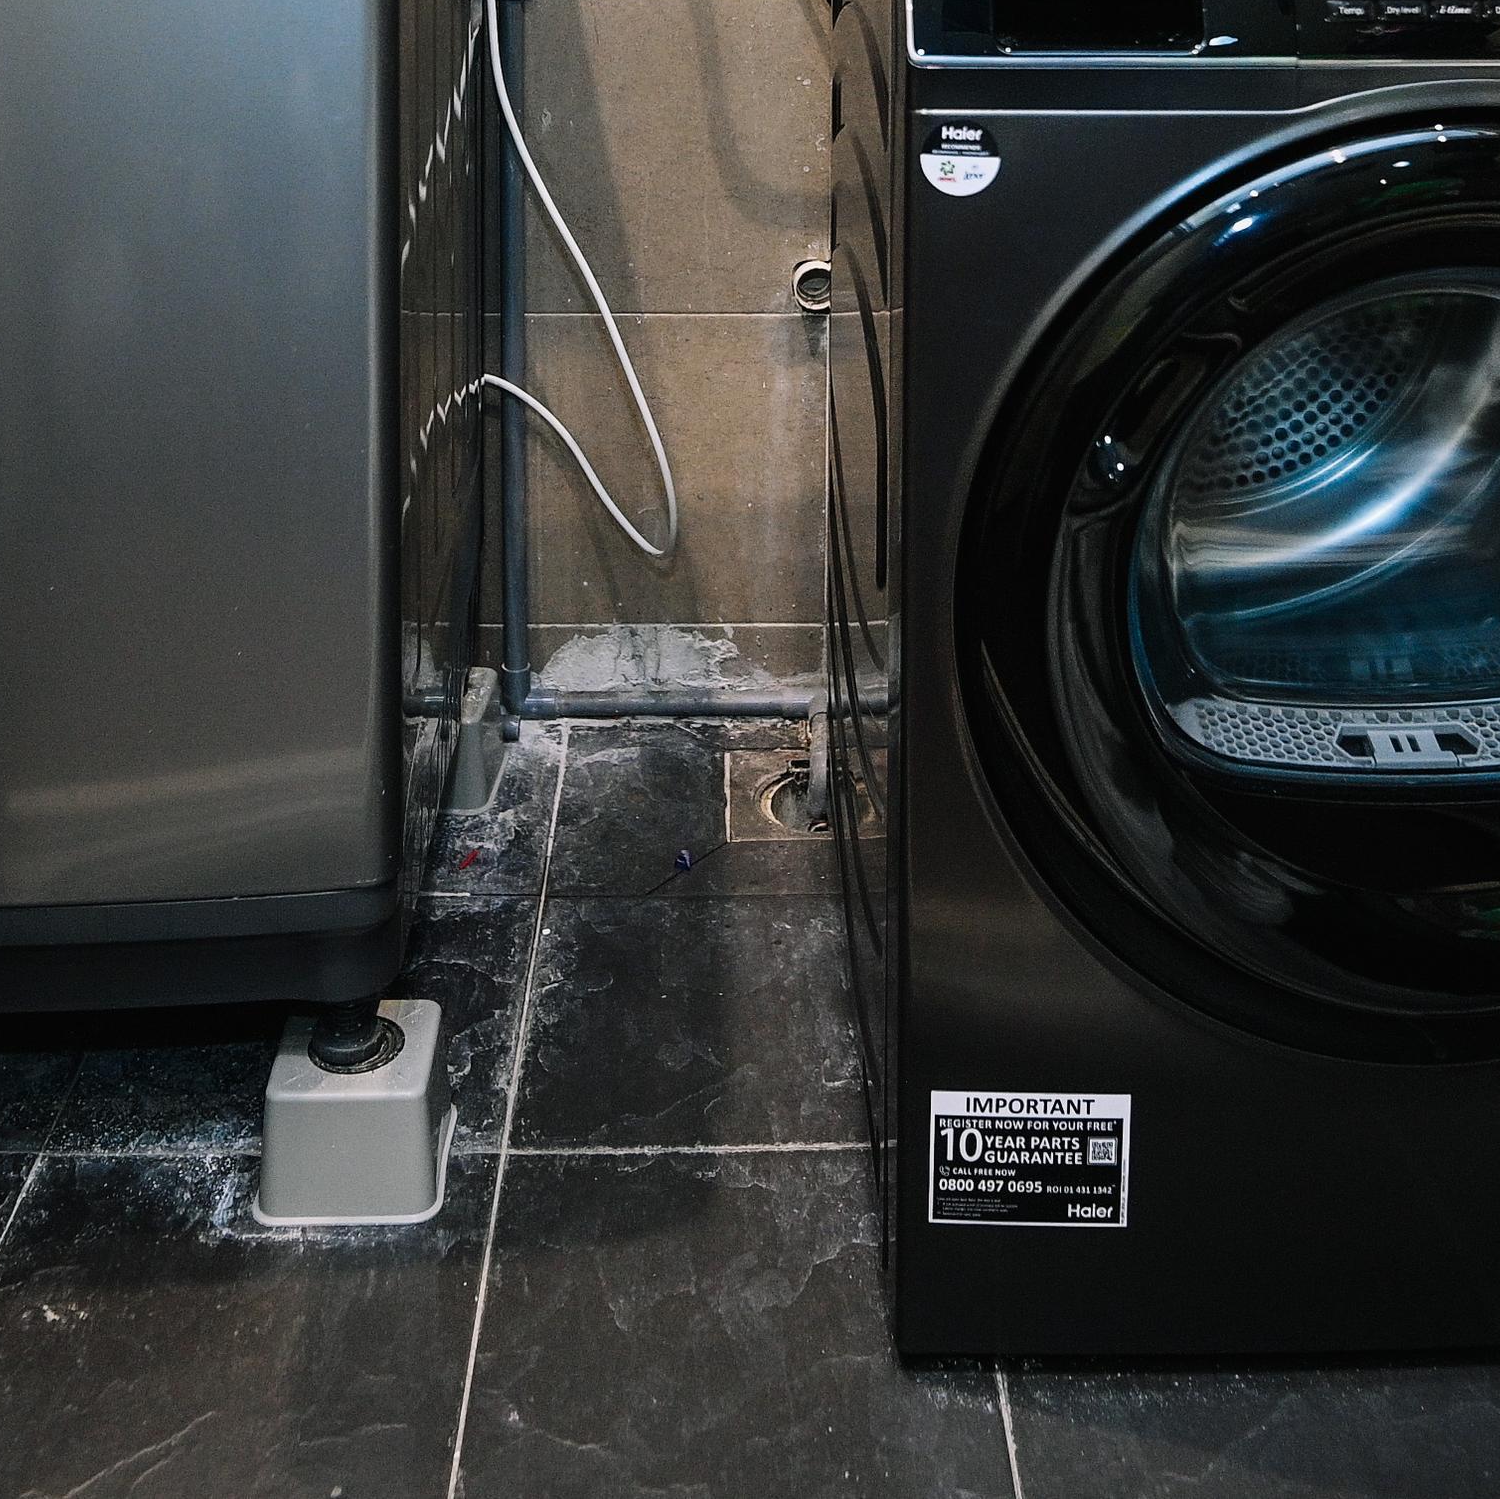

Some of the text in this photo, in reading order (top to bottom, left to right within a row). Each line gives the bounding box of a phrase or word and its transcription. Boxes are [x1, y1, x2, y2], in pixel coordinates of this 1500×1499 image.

[1387, 7, 1400, 15] Dry
[941, 126, 983, 141] Haier
[966, 1097, 1095, 1115] IMPORTANT
[940, 1119, 992, 1129] REGISTER
[996, 1120, 1024, 1130] NOW
[1027, 1120, 1049, 1130] FOR
[1052, 1121, 1083, 1131] YOUR
[940, 1128, 983, 1162] 10
[984, 1136, 1080, 1150] YEAR PARTS
[984, 1151, 1083, 1165] GUARANTEE
[953, 1167, 1016, 1177] CALL FREE NOW
[939, 1179, 975, 1192] 0800
[978, 1180, 1003, 1192] 497
[1008, 1181, 1042, 1193] 0695
[1047, 1185, 1062, 1193] ROI
[1064, 1185, 1073, 1194] 01
[1068, 1203, 1113, 1218] Haier
